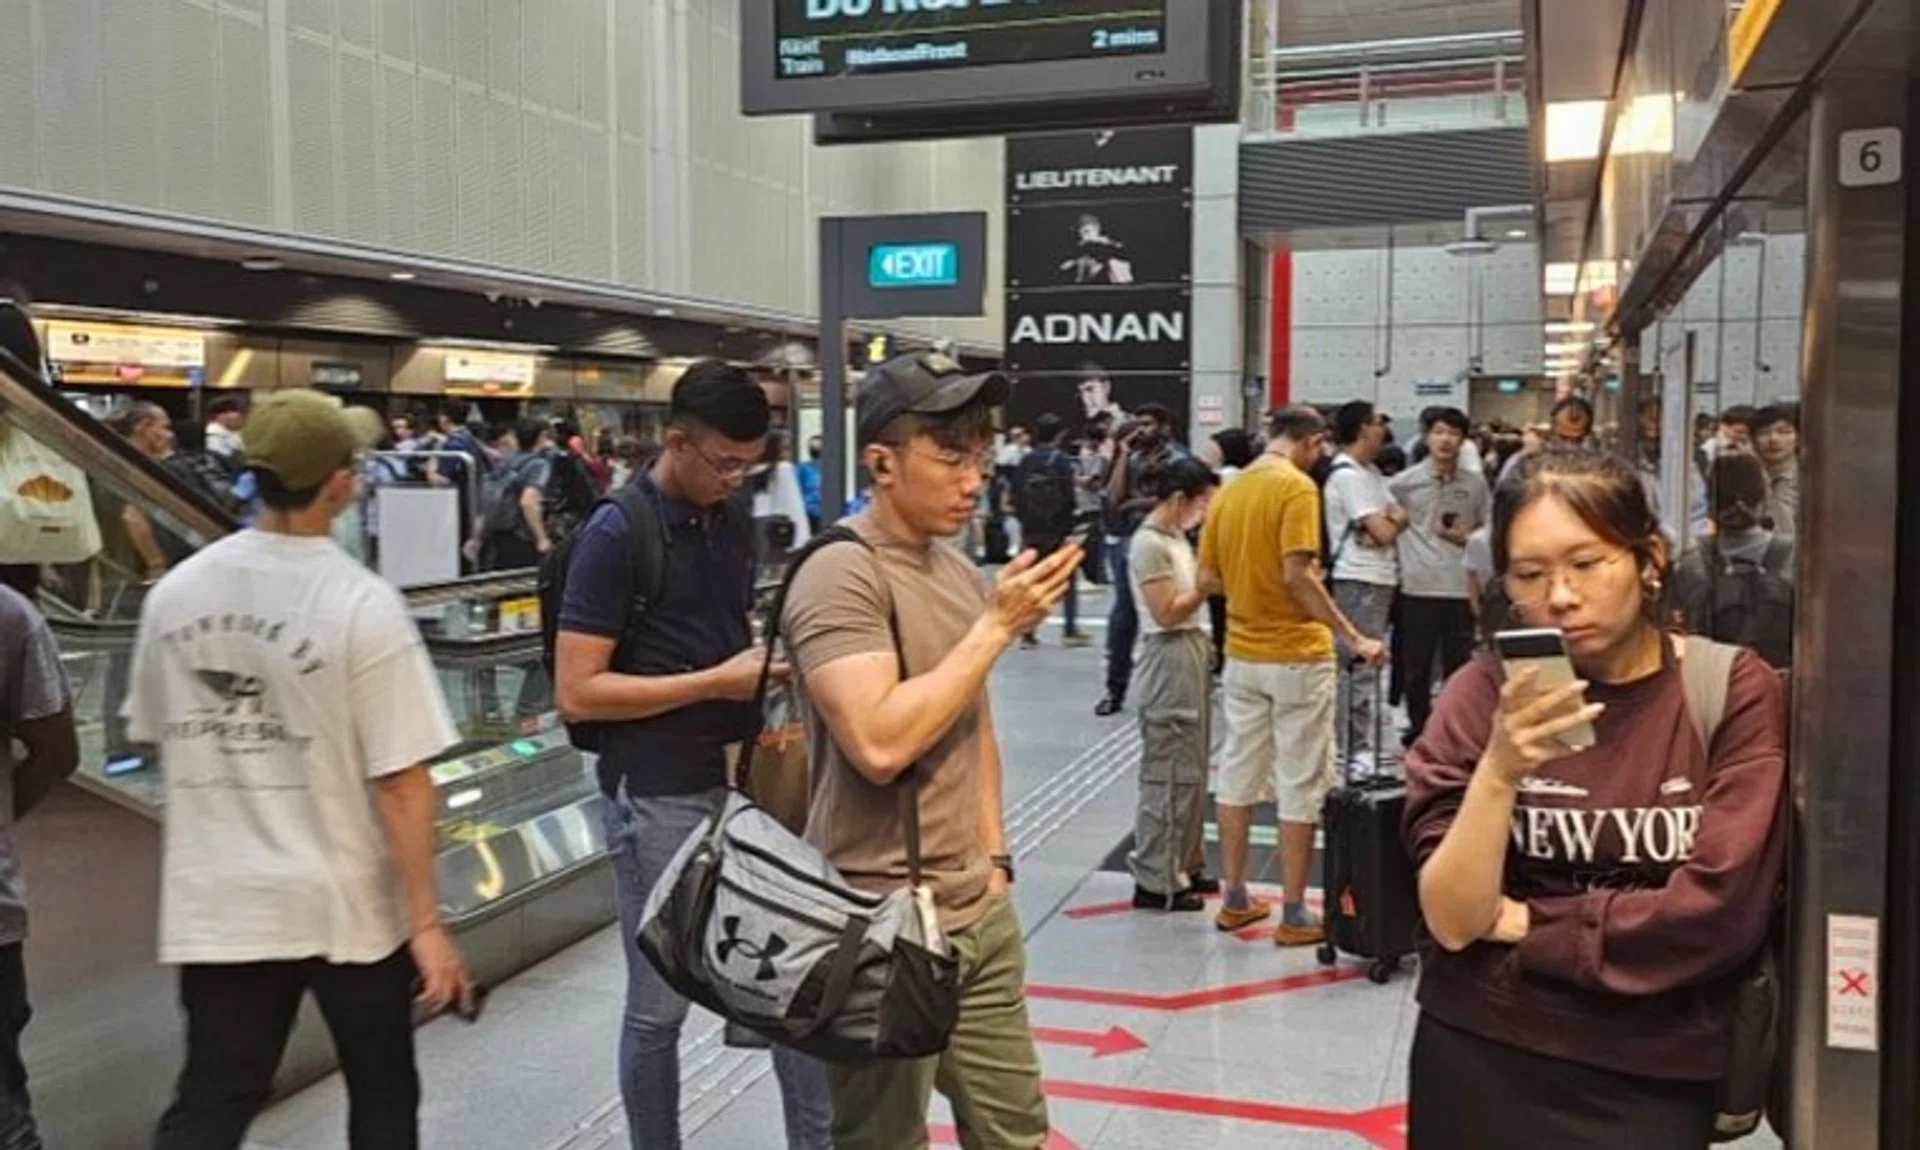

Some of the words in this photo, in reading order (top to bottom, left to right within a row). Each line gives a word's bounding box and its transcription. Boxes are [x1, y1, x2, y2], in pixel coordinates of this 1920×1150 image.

[1860, 140, 1882, 173] 6
[1015, 165, 1180, 190] LIEUTENANT
[895, 248, 949, 279] EXIT
[1010, 311, 1185, 345] ADNAN
[1607, 803, 1706, 863] YOR
